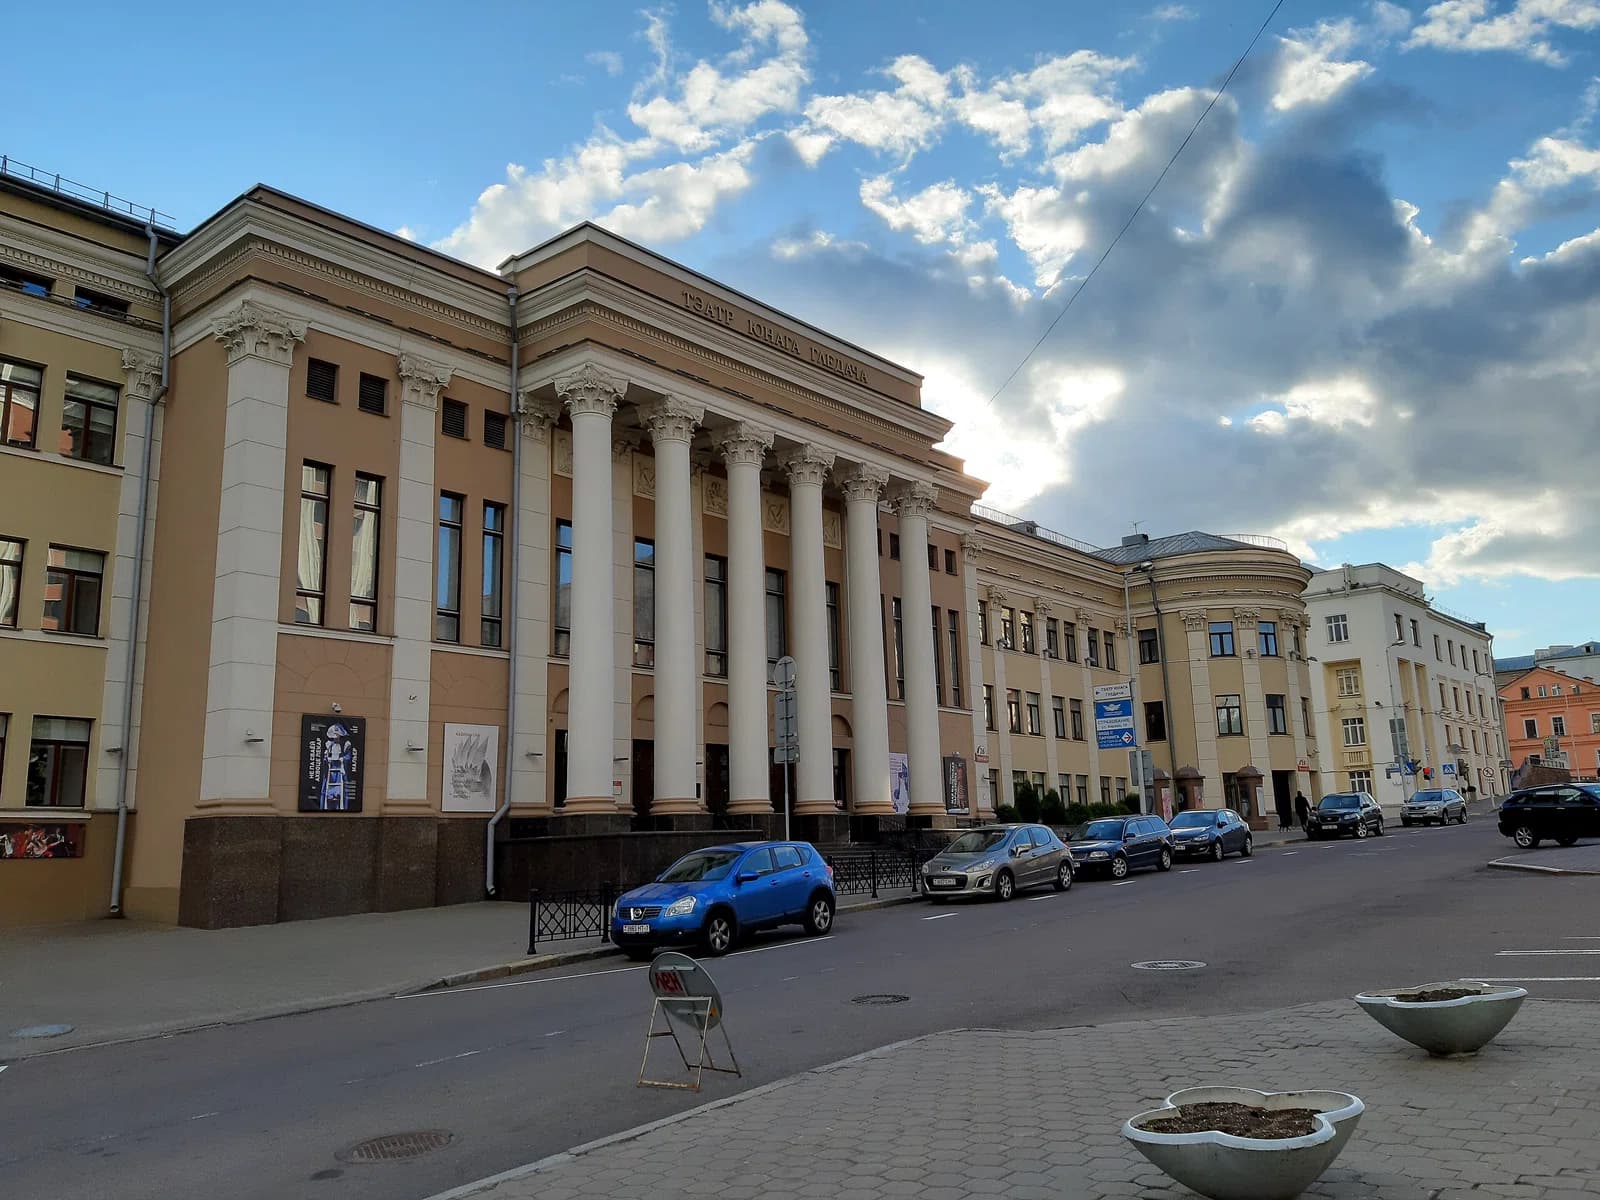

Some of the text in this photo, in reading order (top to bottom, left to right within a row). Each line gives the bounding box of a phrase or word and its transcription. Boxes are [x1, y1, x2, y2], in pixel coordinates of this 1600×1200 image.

[681, 290, 869, 384] ТЭАТР ЮНАГА ГЛЕДАЧА
